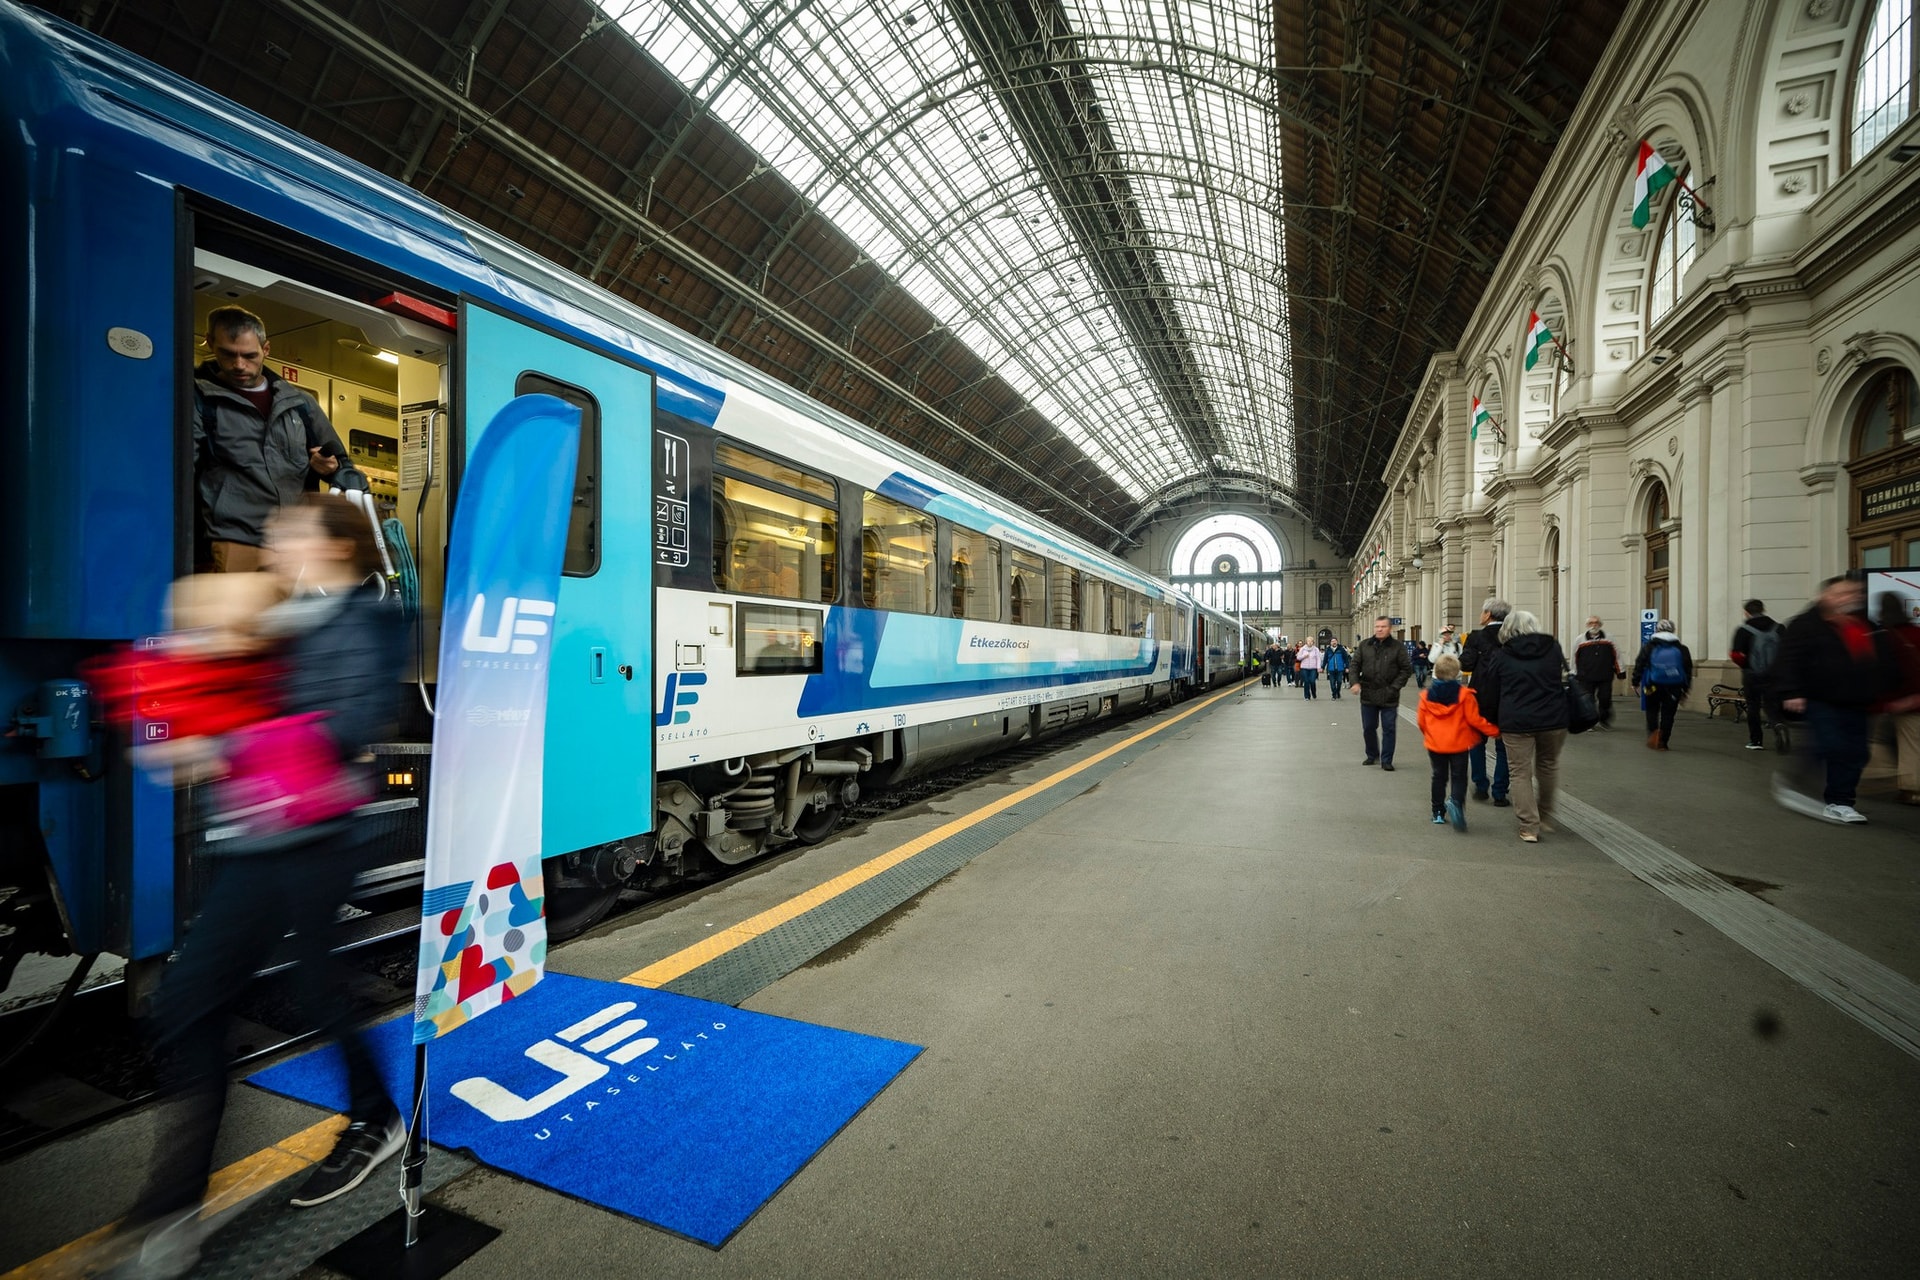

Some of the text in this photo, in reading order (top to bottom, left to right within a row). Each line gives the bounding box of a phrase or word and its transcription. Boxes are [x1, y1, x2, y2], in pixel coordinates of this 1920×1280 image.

[1868, 498, 1910, 516] GOVERNMENT
[1003, 531, 1037, 549] Speisewagen
[1047, 549, 1061, 559] Dining
[462, 593, 556, 655] UE
[970, 635, 1030, 649] Étkezőkocsi
[534, 1022, 727, 1140] UTASELLÁTÓ
